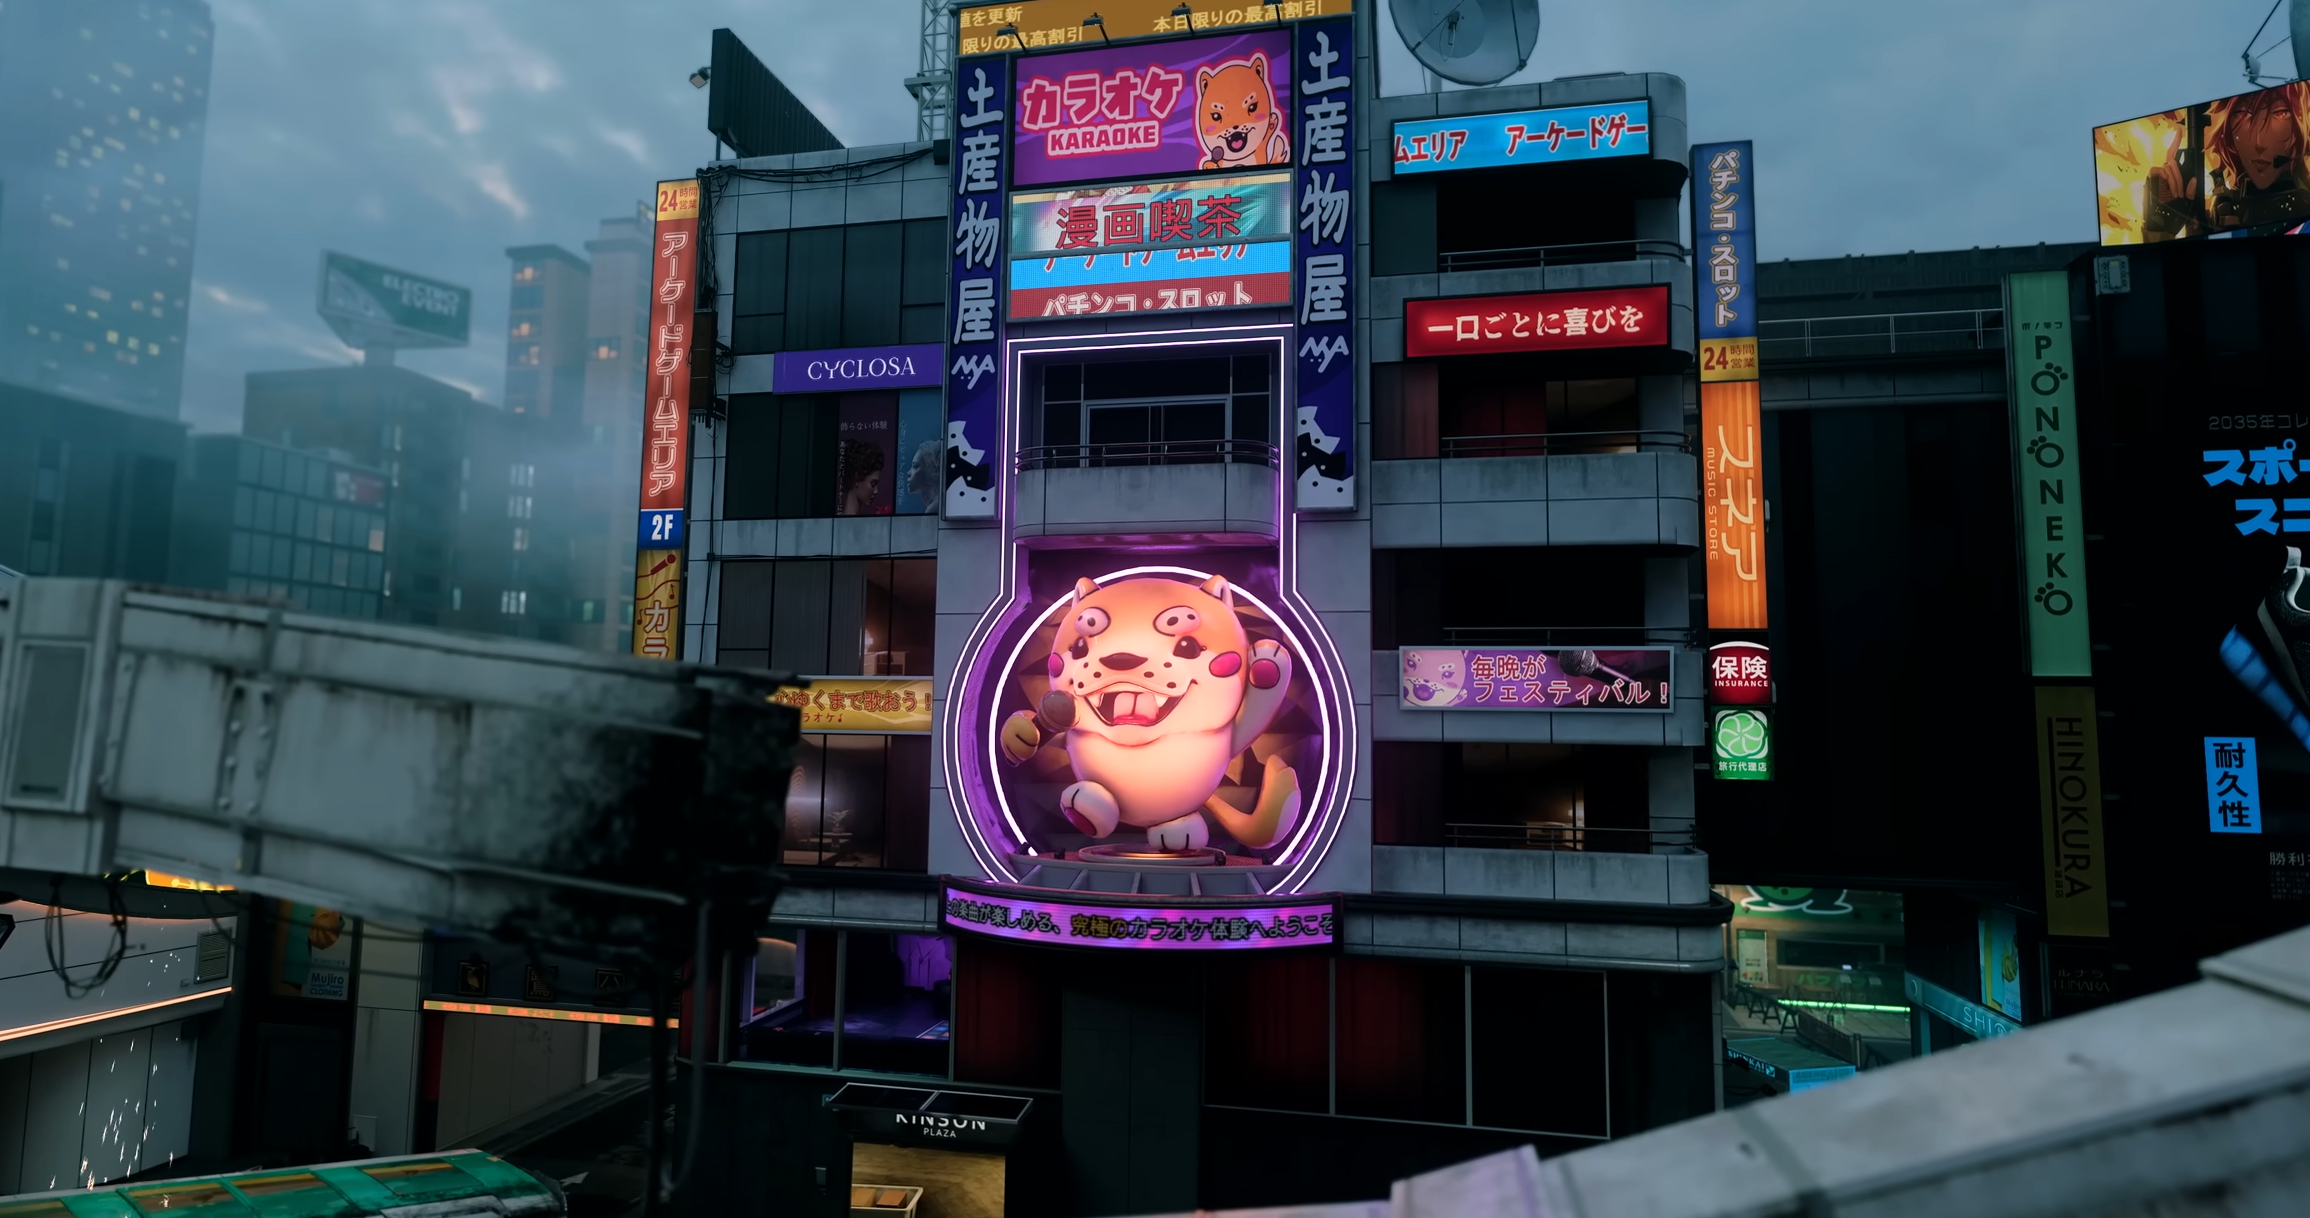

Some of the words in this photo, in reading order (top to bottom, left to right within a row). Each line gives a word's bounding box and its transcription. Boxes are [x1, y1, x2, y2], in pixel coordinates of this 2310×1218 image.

[1023, 66, 1183, 130] カラオケ
[1049, 122, 1159, 155] KARAOKE
[1300, 31, 1351, 326] 土産物屋
[659, 189, 678, 213] 24
[679, 187, 698, 199] 時間
[679, 199, 698, 210] 営業
[953, 67, 1005, 346] 土産物屋
[1055, 194, 1242, 250] 漫画喫茶
[1709, 148, 1740, 328] パチンコ・スロット
[1427, 305, 1644, 342] 一口ごとに喜びを
[1703, 347, 1729, 371] 24
[1730, 343, 1755, 356] 時間
[1730, 356, 1755, 370] 営業
[648, 231, 689, 498] アーケードゲームエリア
[807, 357, 916, 380] CYCLOSA
[2028, 335, 2074, 616] PONONEKO
[2202, 438, 2310, 488] スポ
[1718, 424, 1758, 582] スネア
[651, 514, 674, 541] 2F
[1708, 506, 1719, 561] STORE
[1471, 654, 1547, 682] 毎晩が
[1711, 655, 1768, 680] 保険
[1473, 678, 1668, 705] フェスティバル！
[1714, 680, 1769, 689] INSURANCE
[1718, 761, 1768, 773] 旅行代理店
[2212, 741, 2252, 828] 耐久性
[2056, 716, 2093, 899] HINOKURA
[2269, 851, 2310, 867] 勝利
[309, 987, 343, 998] CLOTHING
[311, 972, 344, 987] Mujiro
[923, 1127, 957, 1139] PLAZA
